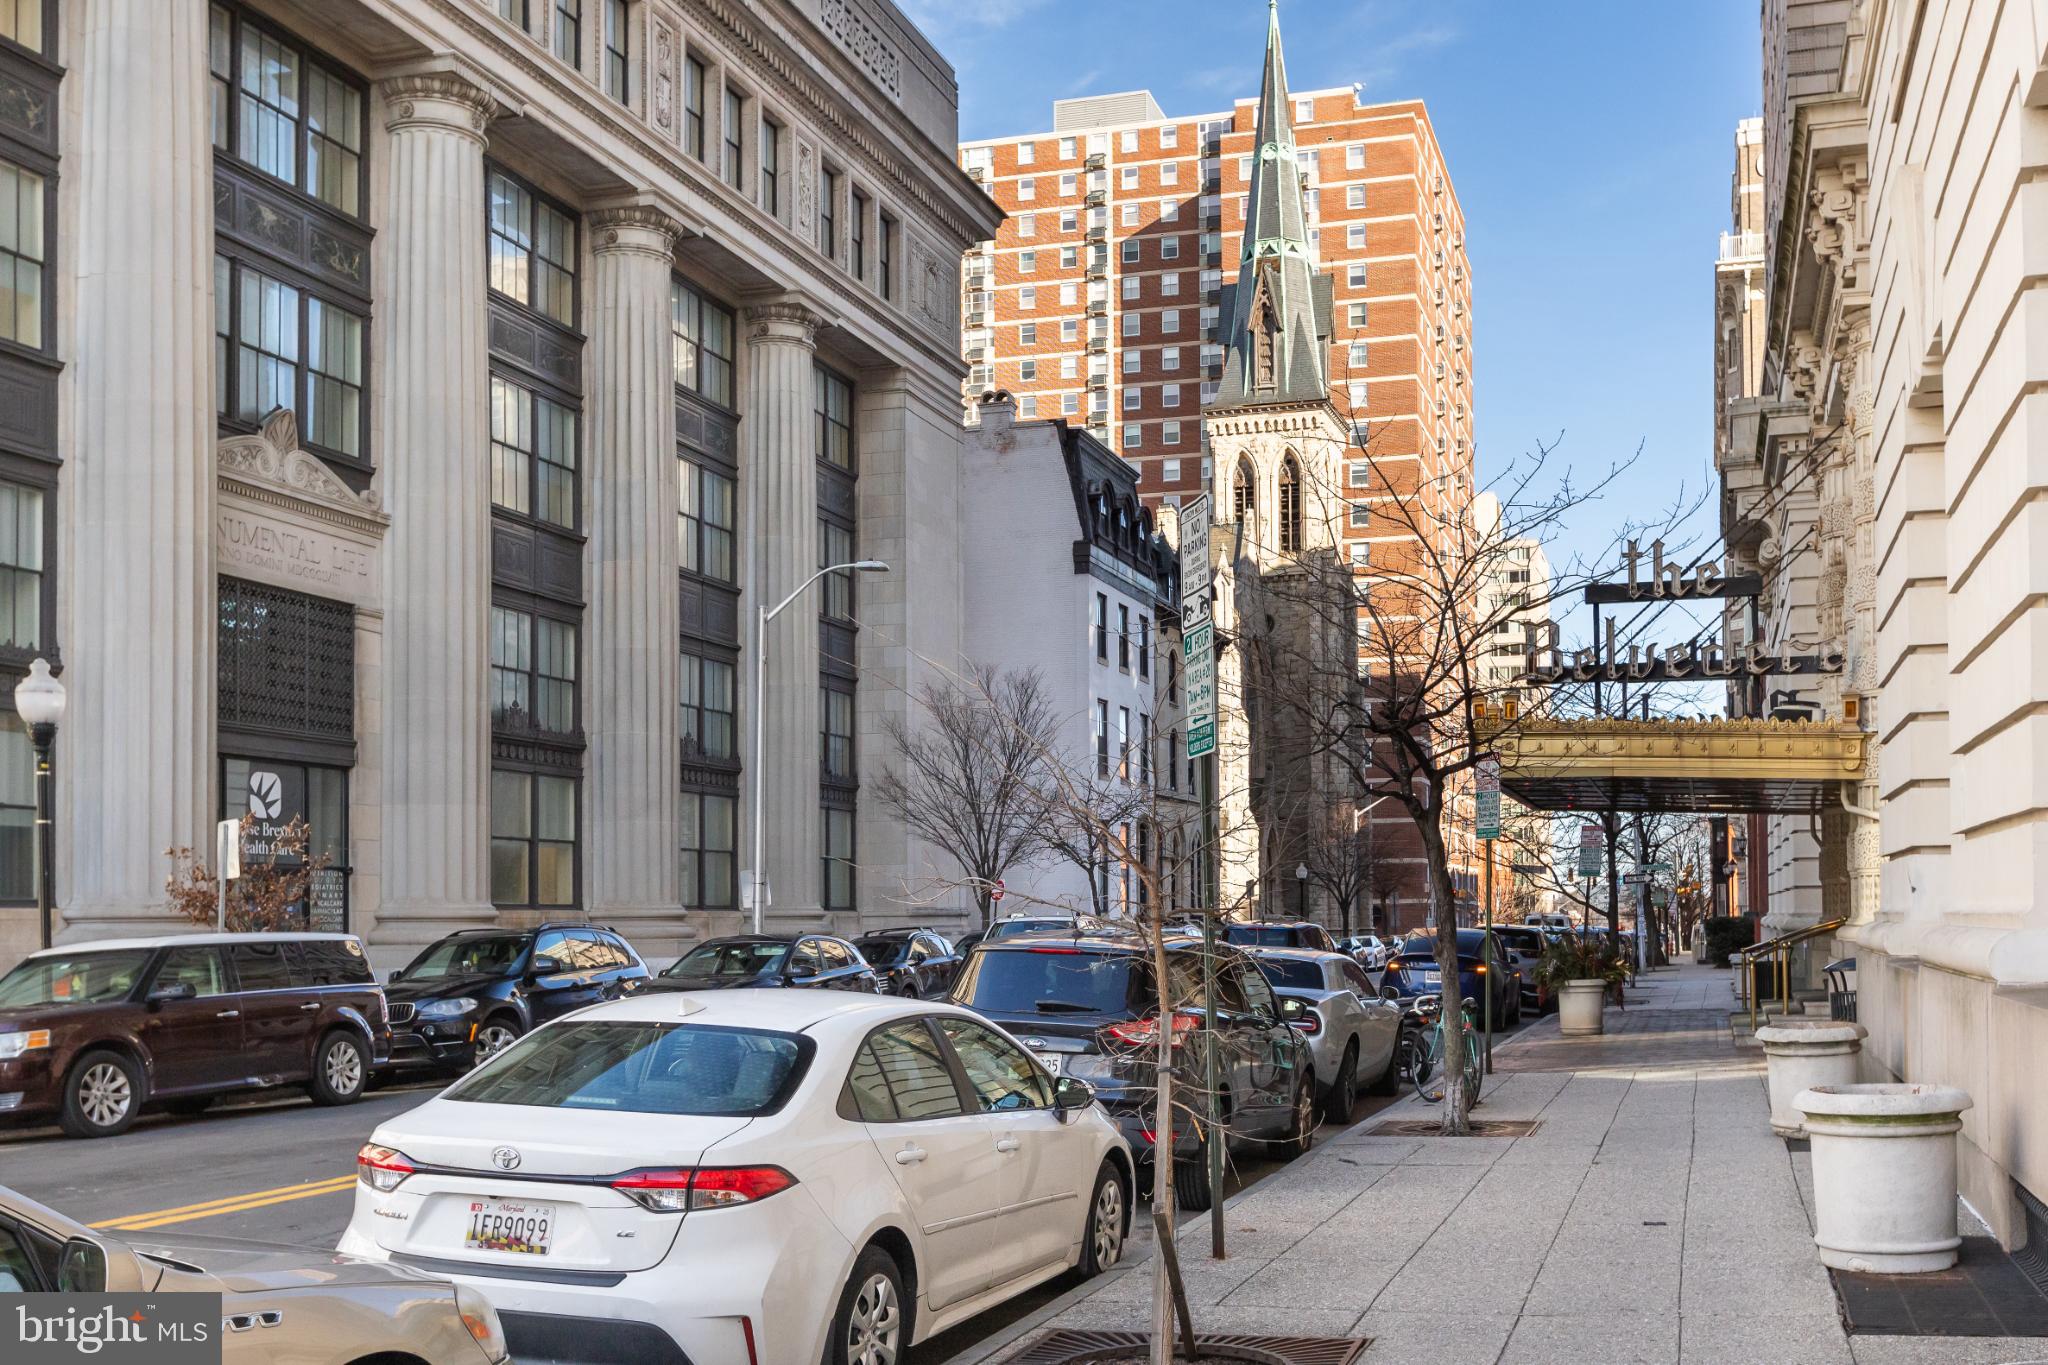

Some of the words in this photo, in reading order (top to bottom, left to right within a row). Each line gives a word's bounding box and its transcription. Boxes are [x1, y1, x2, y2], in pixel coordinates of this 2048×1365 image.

[1191, 518, 1201, 537] NO
[1184, 532, 1207, 559] PARKING
[246, 553, 284, 572] DOMINI
[333, 545, 367, 577] LIFE
[1621, 538, 1727, 600] the
[1186, 636, 1191, 653] 2
[1194, 629, 1210, 650] HOUR
[1515, 616, 1846, 684] Belvedere
[498, 1203, 526, 1215] Maryland
[616, 1230, 637, 1238] LE
